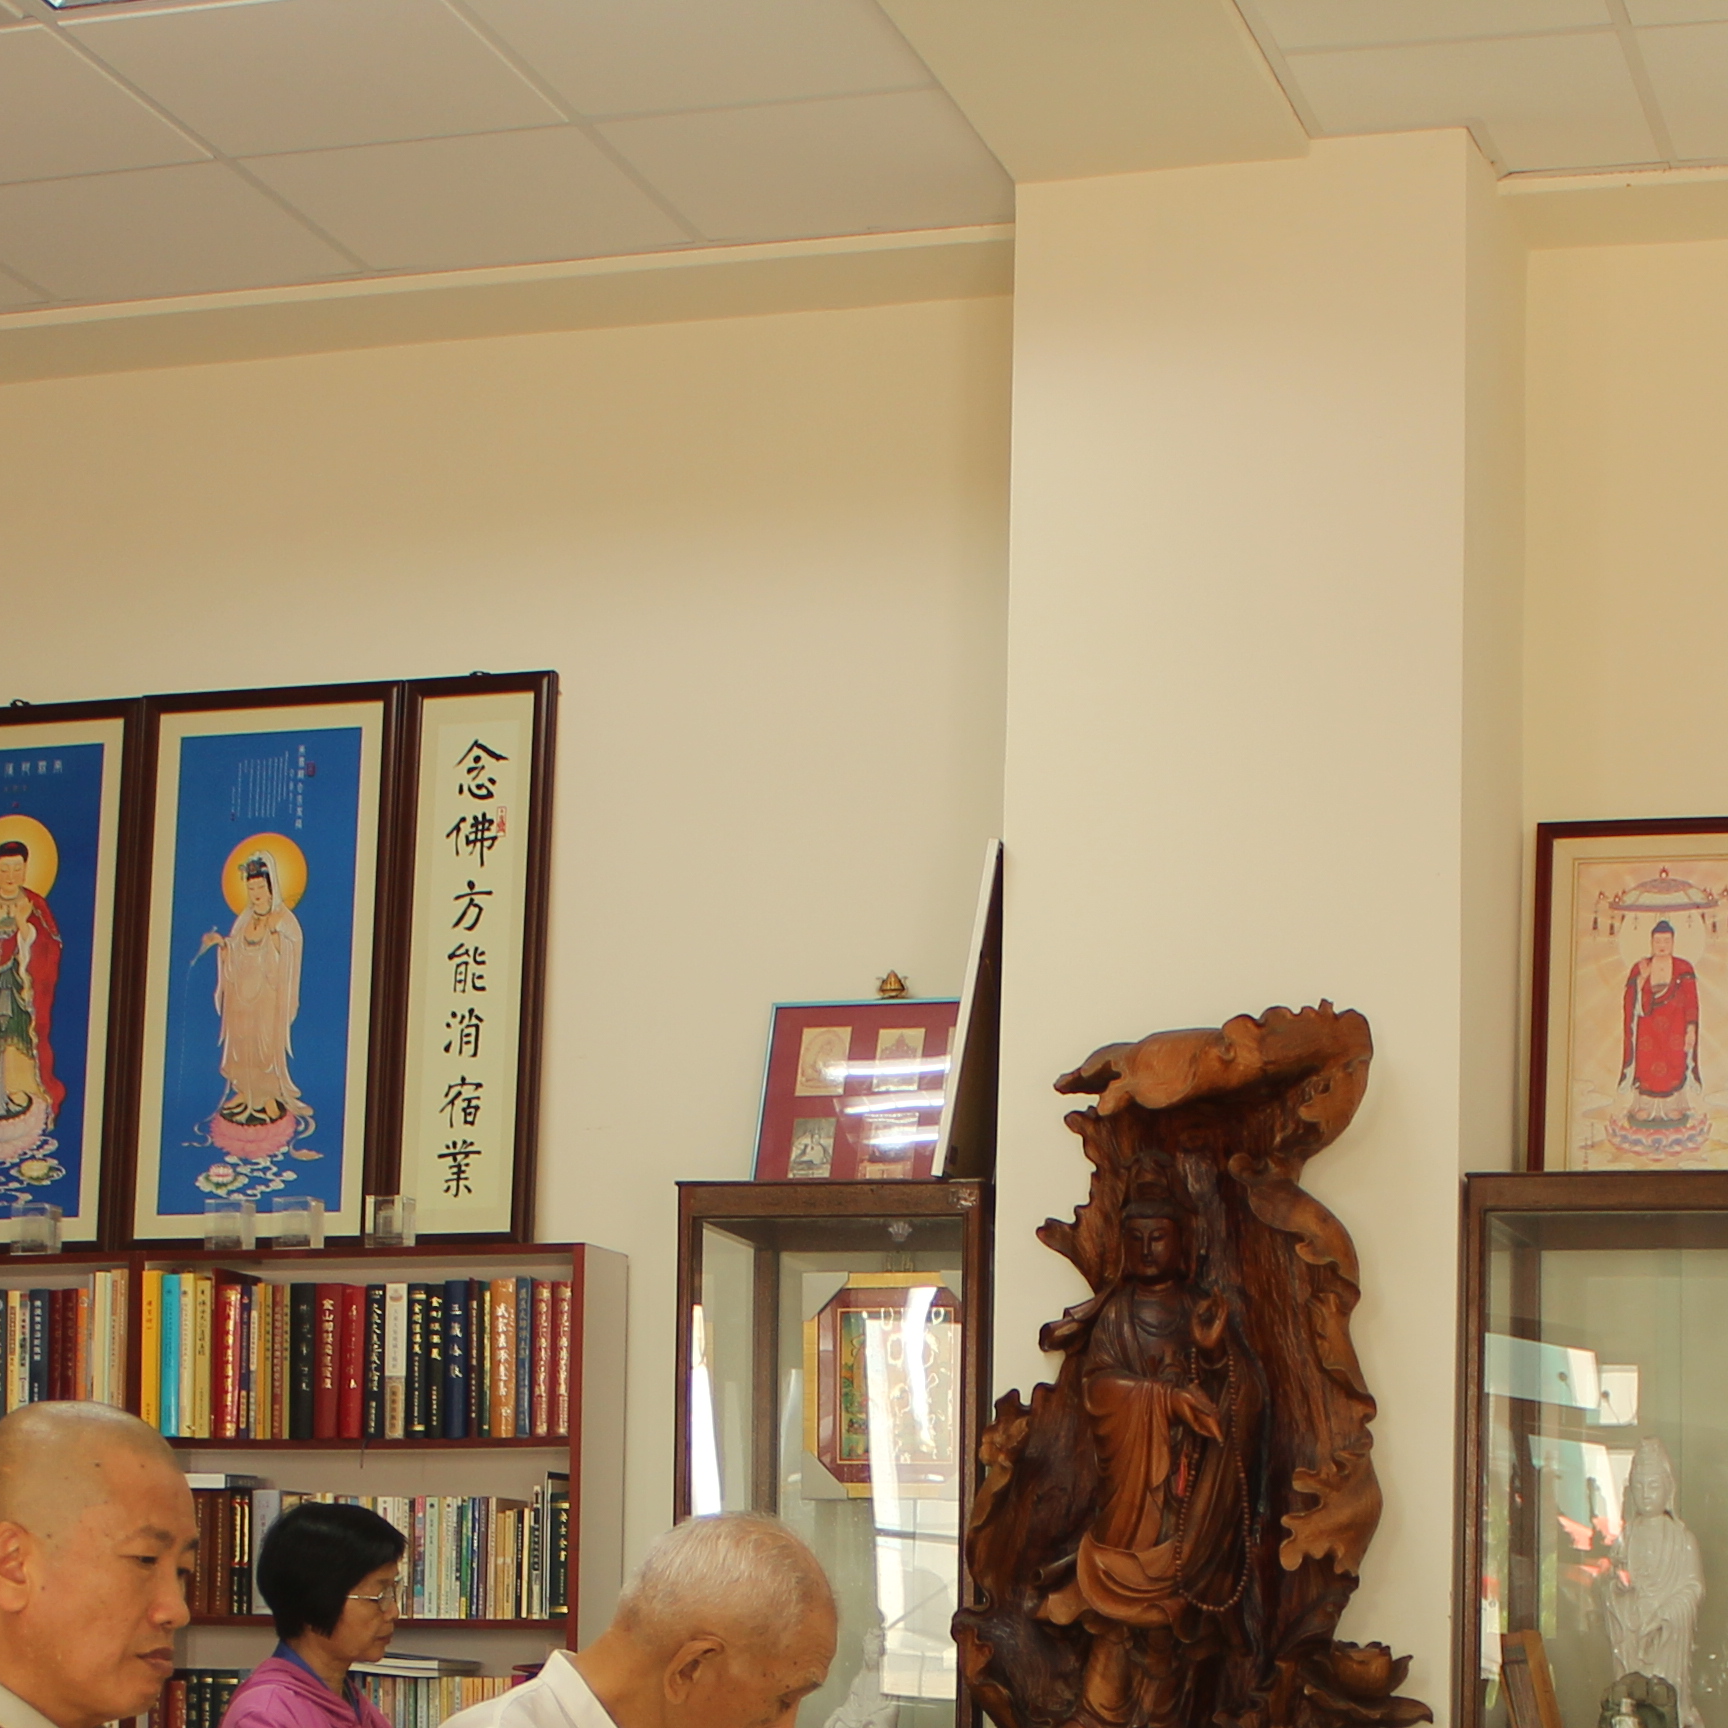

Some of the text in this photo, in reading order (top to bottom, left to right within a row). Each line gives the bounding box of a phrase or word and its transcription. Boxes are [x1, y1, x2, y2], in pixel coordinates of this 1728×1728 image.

[438, 738, 510, 1198] 念佛方能消宿業
